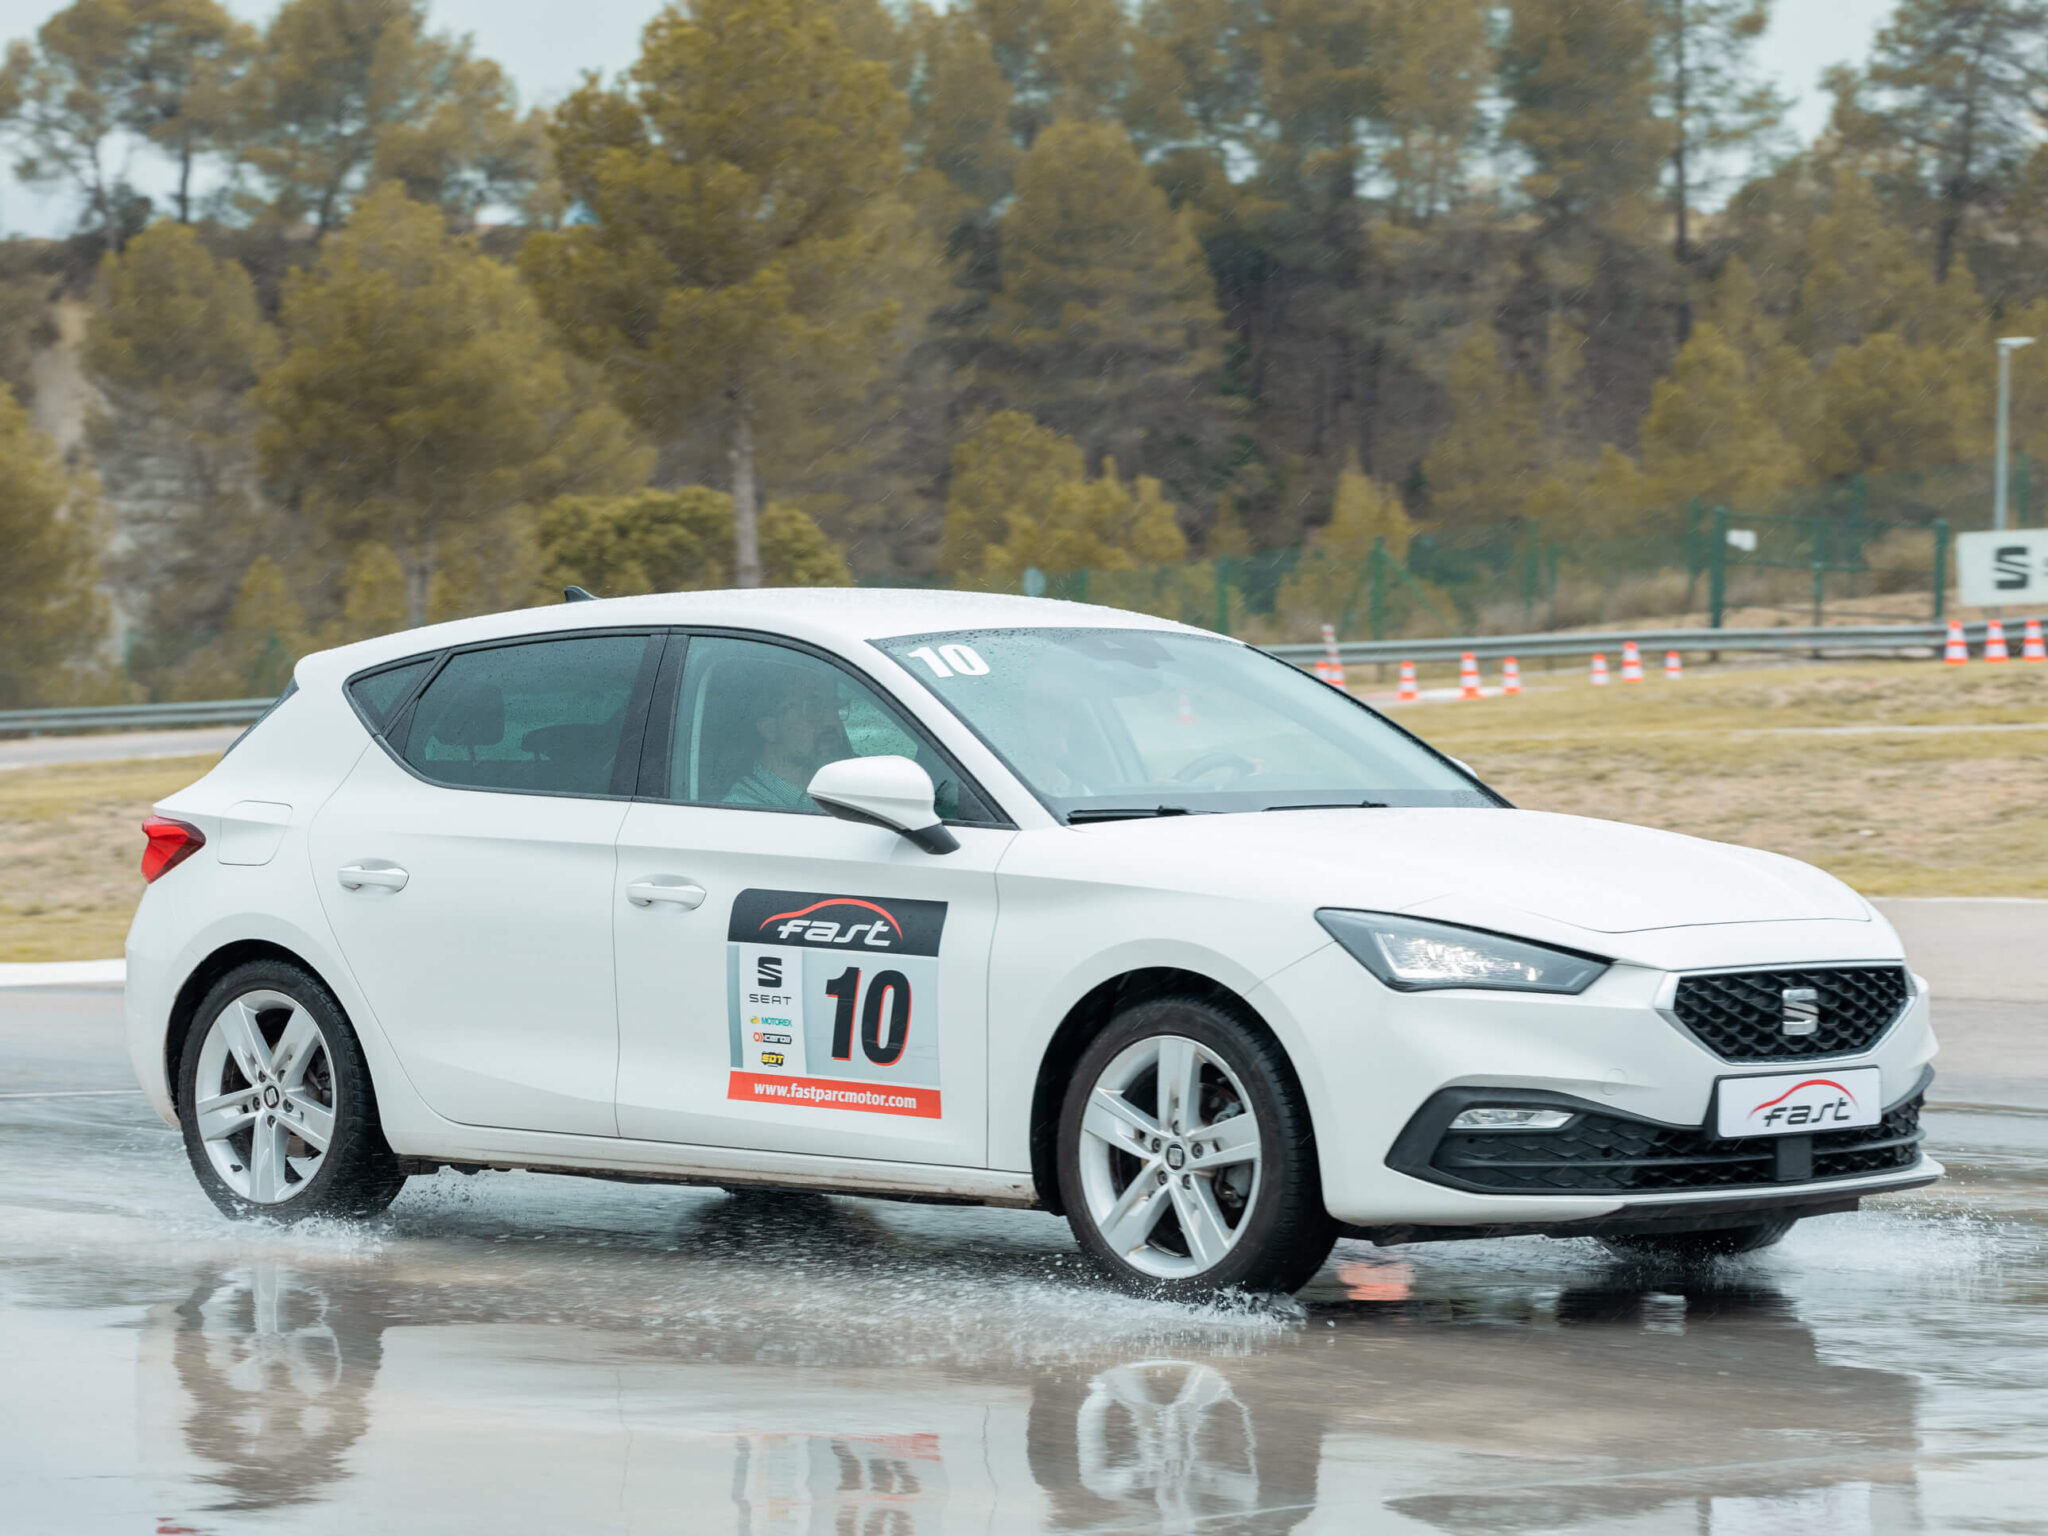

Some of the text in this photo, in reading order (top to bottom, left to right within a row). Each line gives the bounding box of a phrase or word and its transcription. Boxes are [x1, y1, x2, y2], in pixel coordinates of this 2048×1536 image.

[907, 644, 990, 678] 10
[777, 919, 891, 947] fast
[749, 993, 792, 1006] SEAT
[825, 966, 912, 1067] 10
[762, 1053, 785, 1065] SDT
[754, 1082, 917, 1109] www.fastparcmotor.com
[1763, 1097, 1850, 1128] fast
